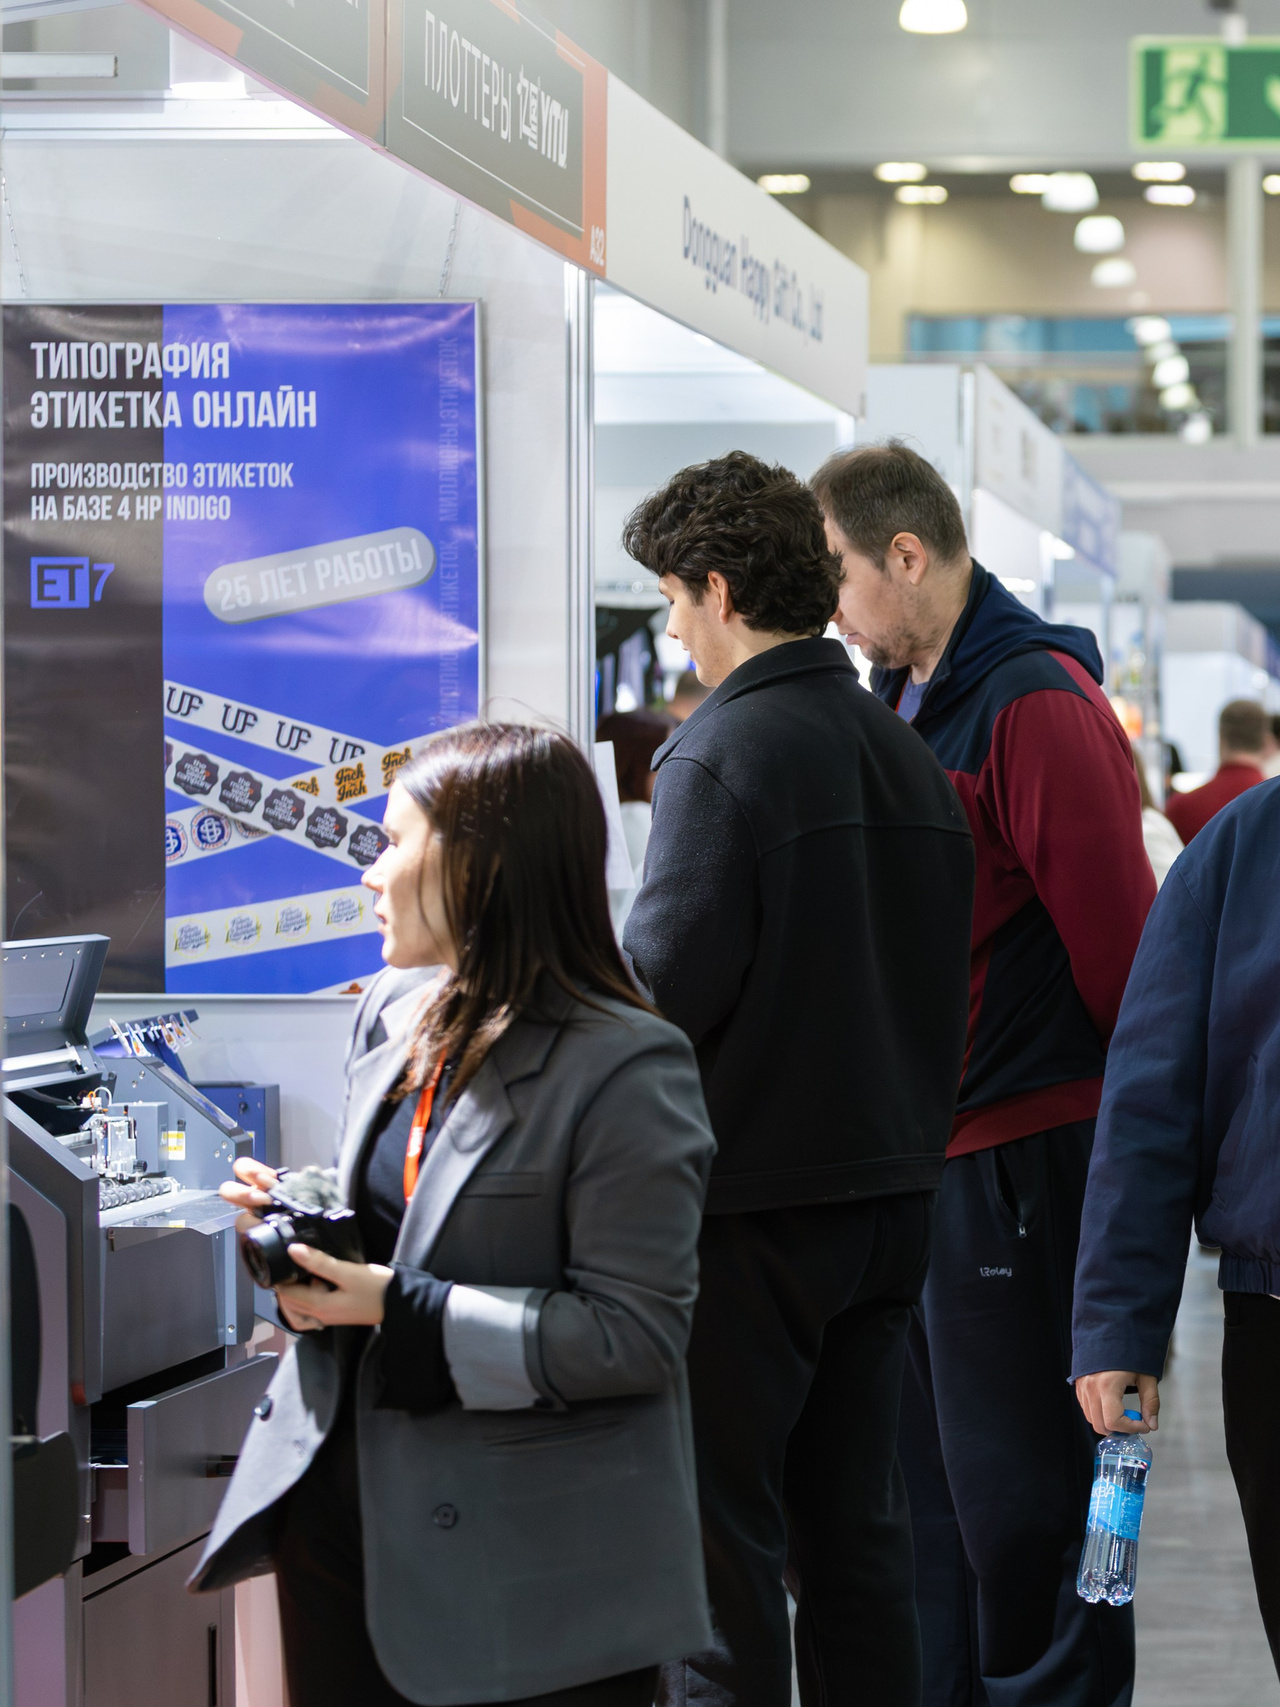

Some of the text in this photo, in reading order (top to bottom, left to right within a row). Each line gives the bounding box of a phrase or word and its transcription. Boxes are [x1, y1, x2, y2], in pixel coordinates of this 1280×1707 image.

[425, 9, 511, 143] ПЛОТТЕРЫ
[30, 341, 230, 379] ТИПОГРАФИЯ
[30, 384, 317, 428] ЭТИКЕТКА ОНЛАЙН
[30, 462, 294, 490] ПРОИЗВОДСТВО ЭТИКЕТОК
[31, 495, 231, 521] НА БАЗЕ 4 HP INDIGO
[216, 540, 423, 612] 25 ЛЕТ РАБОТЫ
[334, 763, 366, 787] Inch
[336, 780, 368, 803] Inch
